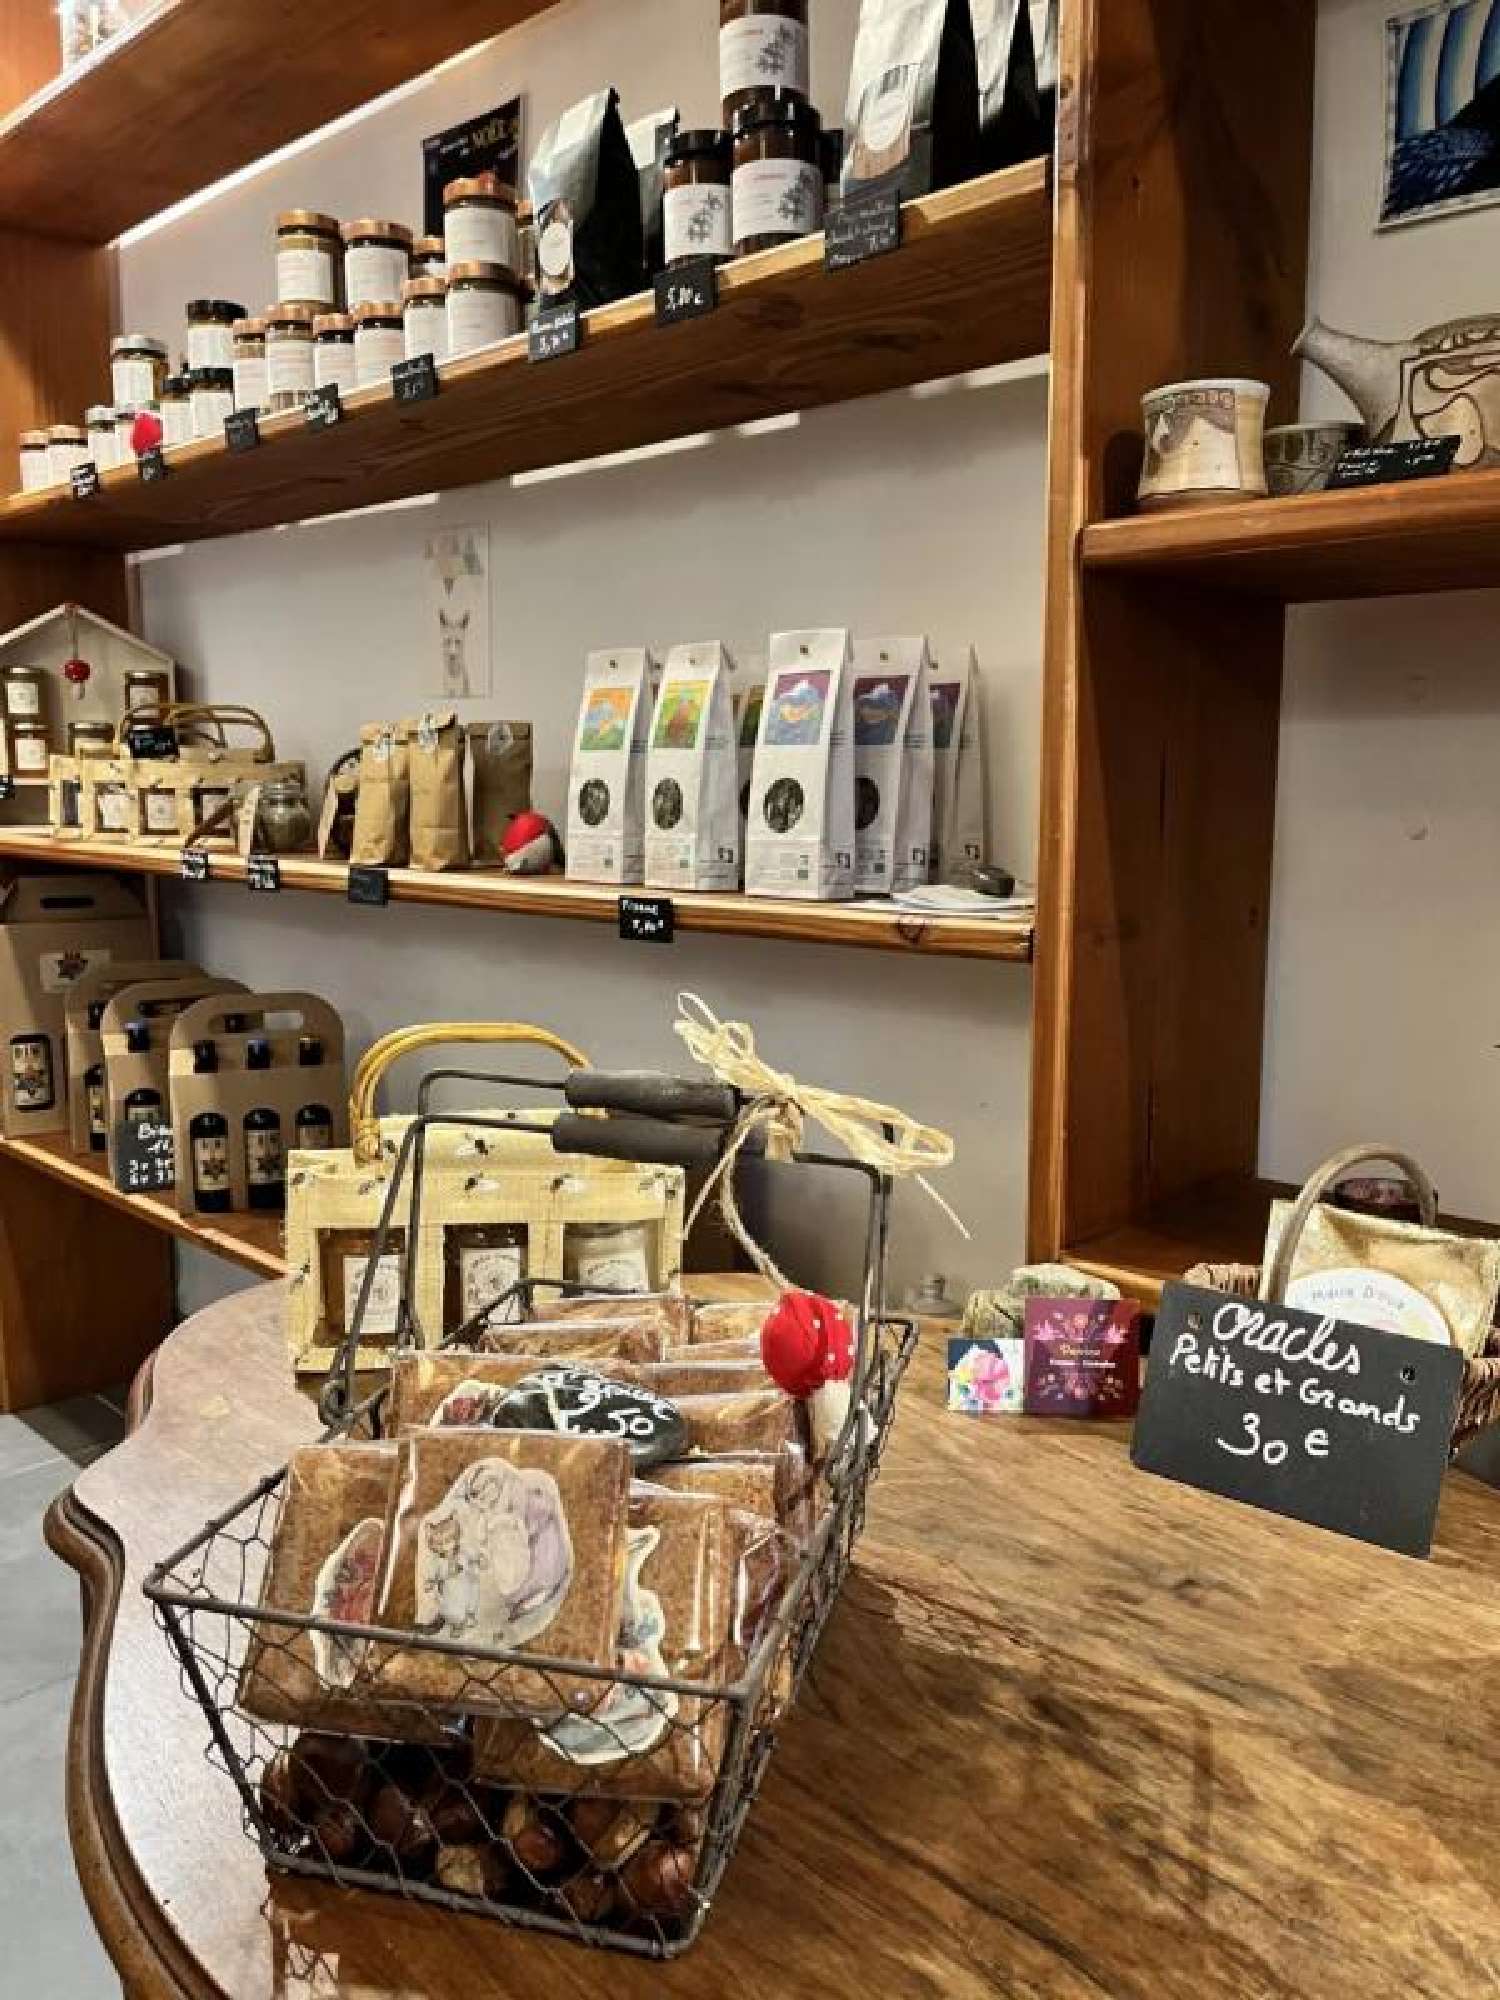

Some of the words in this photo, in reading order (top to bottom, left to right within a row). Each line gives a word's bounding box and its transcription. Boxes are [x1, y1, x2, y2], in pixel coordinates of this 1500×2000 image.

[1213, 1303, 1360, 1375] Oracles
[1170, 1333, 1244, 1386] Petits
[1254, 1368, 1292, 1395] et
[1299, 1378, 1420, 1433] Grands
[1215, 1412, 1289, 1465] 30
